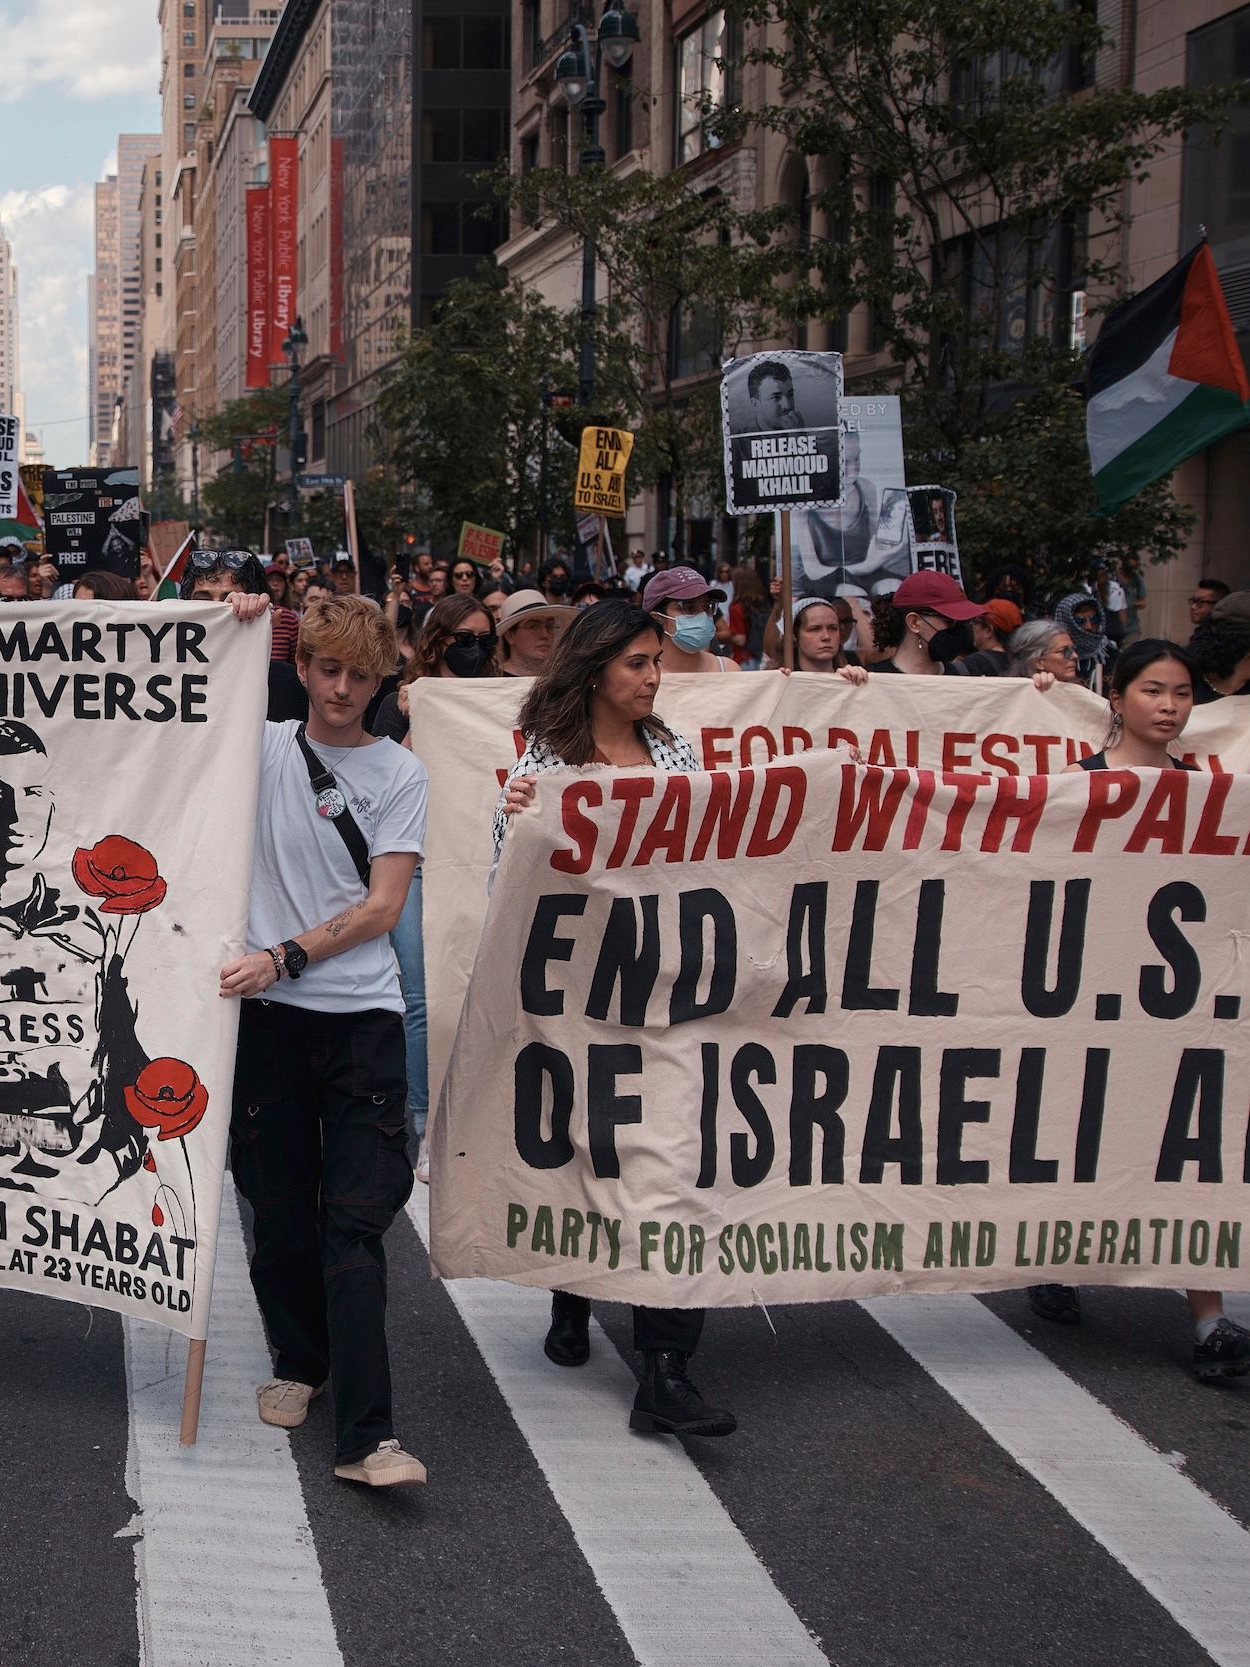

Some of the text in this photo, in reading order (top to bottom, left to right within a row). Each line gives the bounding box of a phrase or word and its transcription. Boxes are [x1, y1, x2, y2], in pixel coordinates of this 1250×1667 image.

[274, 157, 293, 330] New York Public Library
[250, 205, 265, 358] New York Public Library
[867, 403, 887, 416] BY
[751, 436, 817, 458] RELEASE
[742, 455, 828, 479] MAHMOUD
[581, 472, 603, 491] U.S.
[758, 476, 813, 496] KHALIL
[578, 490, 622, 508] TO ISRAE!
[51, 513, 93, 524] PALESTINE
[467, 528, 499, 545] FREE
[58, 552, 86, 564] FREE!
[917, 550, 959, 580] FRE
[551, 764, 1250, 875] STAND WITH PAL
[520, 878, 1240, 1027] END ALL U.S.
[514, 1042, 1250, 1188] OF ISRAELI A
[21, 1205, 195, 1281] SHABAT
[507, 1204, 1242, 1275] PARTY FOR SOCIALISM AND LIBERATION
[9, 1248, 38, 1275] AT
[43, 1255, 72, 1282] 23
[76, 1261, 147, 1301] YEARS
[151, 1280, 191, 1313] OLD
